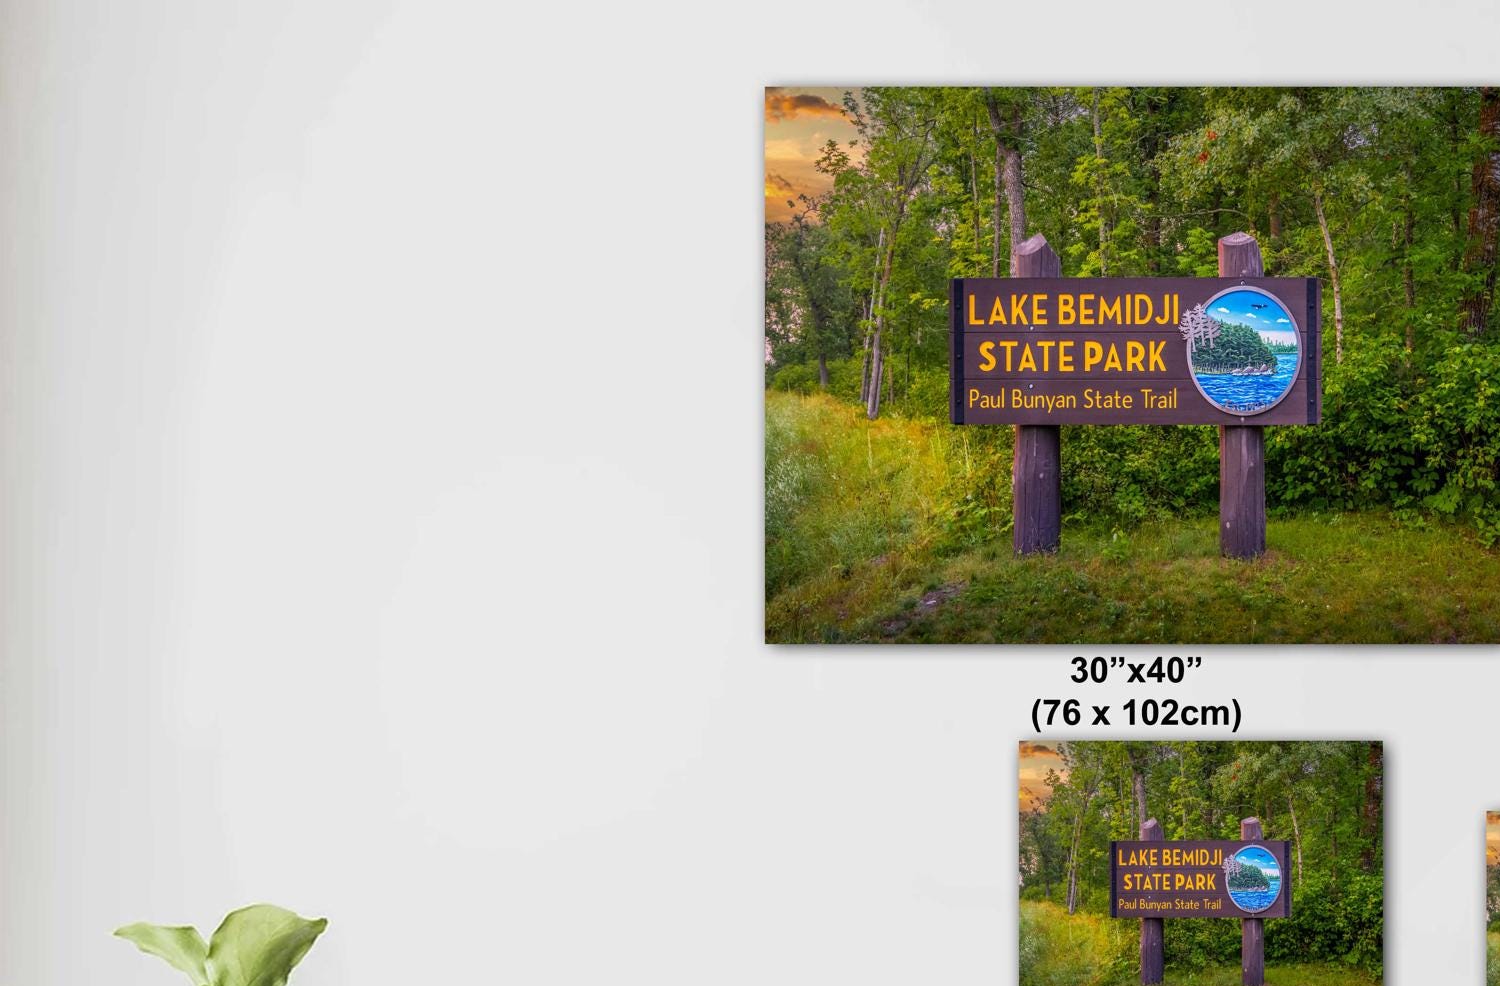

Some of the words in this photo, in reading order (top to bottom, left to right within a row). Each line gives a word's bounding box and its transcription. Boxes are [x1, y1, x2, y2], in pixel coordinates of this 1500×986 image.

[968, 294, 1048, 325] LAKE
[1057, 294, 1180, 326] BEMIDJI
[978, 340, 1074, 372] STATE
[1084, 340, 1167, 372] PARK
[968, 388, 1005, 409] Paul
[1011, 388, 1076, 413] Bunyan
[1083, 388, 1133, 409] State
[1140, 388, 1178, 409] Trail
[1118, 848, 1158, 866] LAKE
[1162, 848, 1222, 867] BEMIDJI
[1123, 873, 1171, 890] STATE
[1175, 873, 1216, 890] PARK
[1118, 898, 1137, 910] Paul
[1139, 898, 1172, 912] Bunyan
[1175, 898, 1200, 910] State
[1204, 898, 1222, 910] Trail
